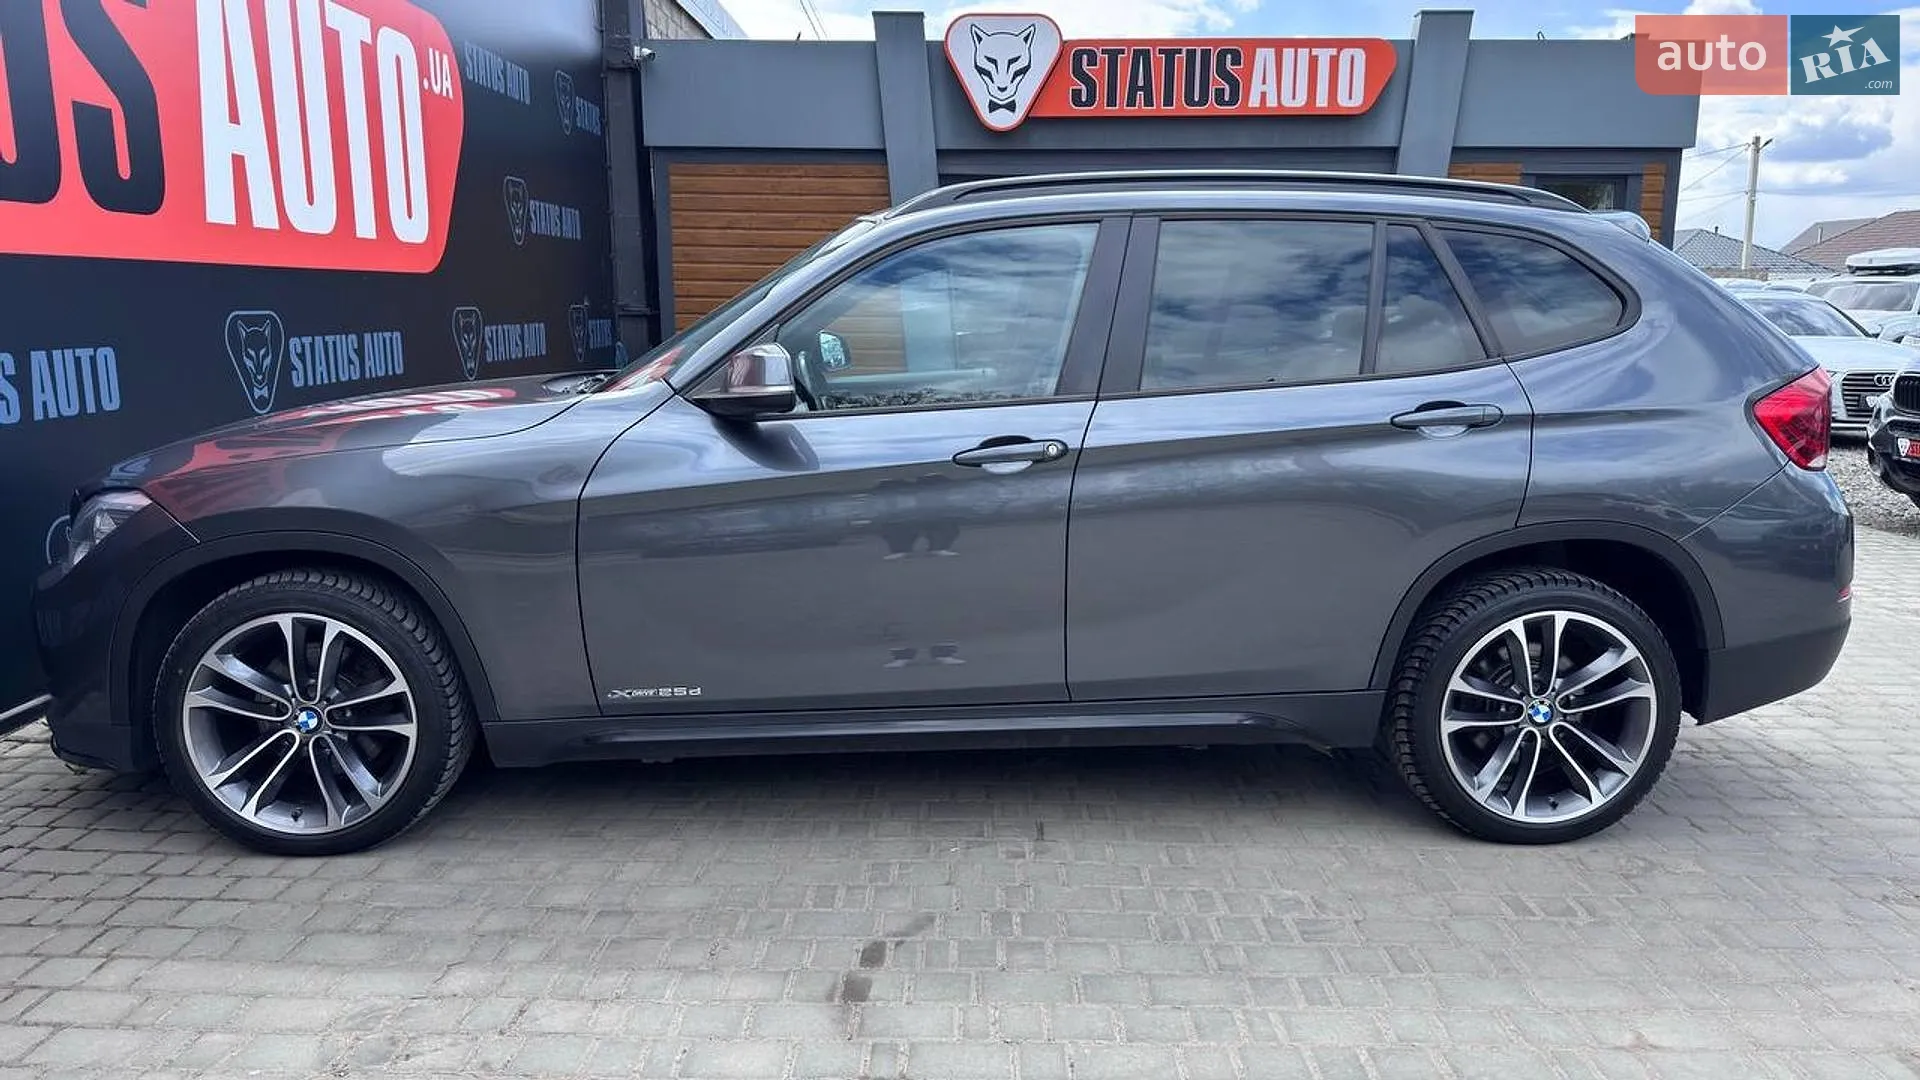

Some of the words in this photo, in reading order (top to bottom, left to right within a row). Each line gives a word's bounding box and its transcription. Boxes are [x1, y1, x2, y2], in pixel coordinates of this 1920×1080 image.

[464, 41, 505, 94] STATUS
[505, 61, 531, 105] AUTO
[1069, 47, 1243, 110] STATUS
[1247, 47, 1367, 108] AUTO
[529, 200, 561, 235] STATUS
[288, 334, 360, 387] STATUS
[363, 331, 404, 379] AUTO
[484, 324, 523, 362] STATUS
[523, 322, 546, 358] AUTO
[30, 347, 120, 421] AUTO
